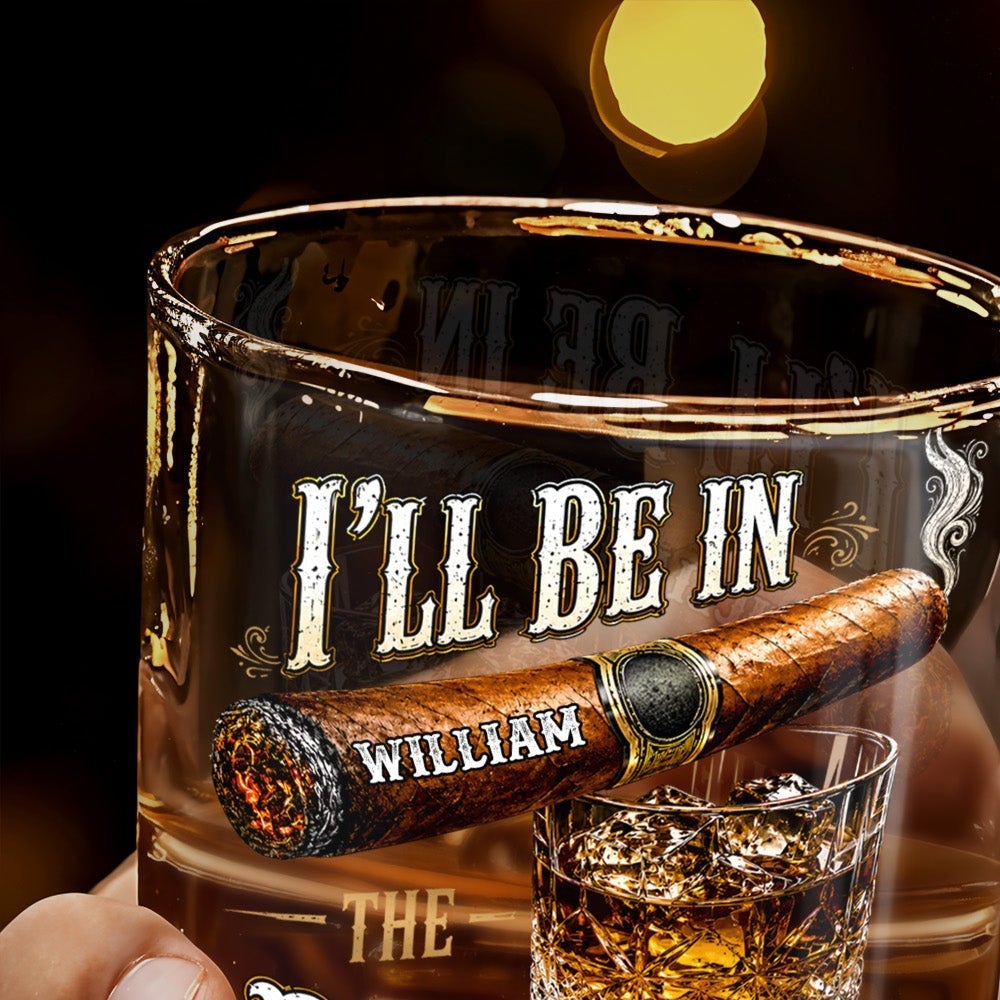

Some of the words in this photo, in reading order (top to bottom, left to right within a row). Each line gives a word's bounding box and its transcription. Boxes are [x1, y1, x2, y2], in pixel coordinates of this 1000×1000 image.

[285, 474, 498, 674] I'LL
[520, 478, 672, 640] BE
[698, 470, 801, 605] IN
[352, 703, 588, 785] WILLIAM
[342, 887, 457, 964] THE
